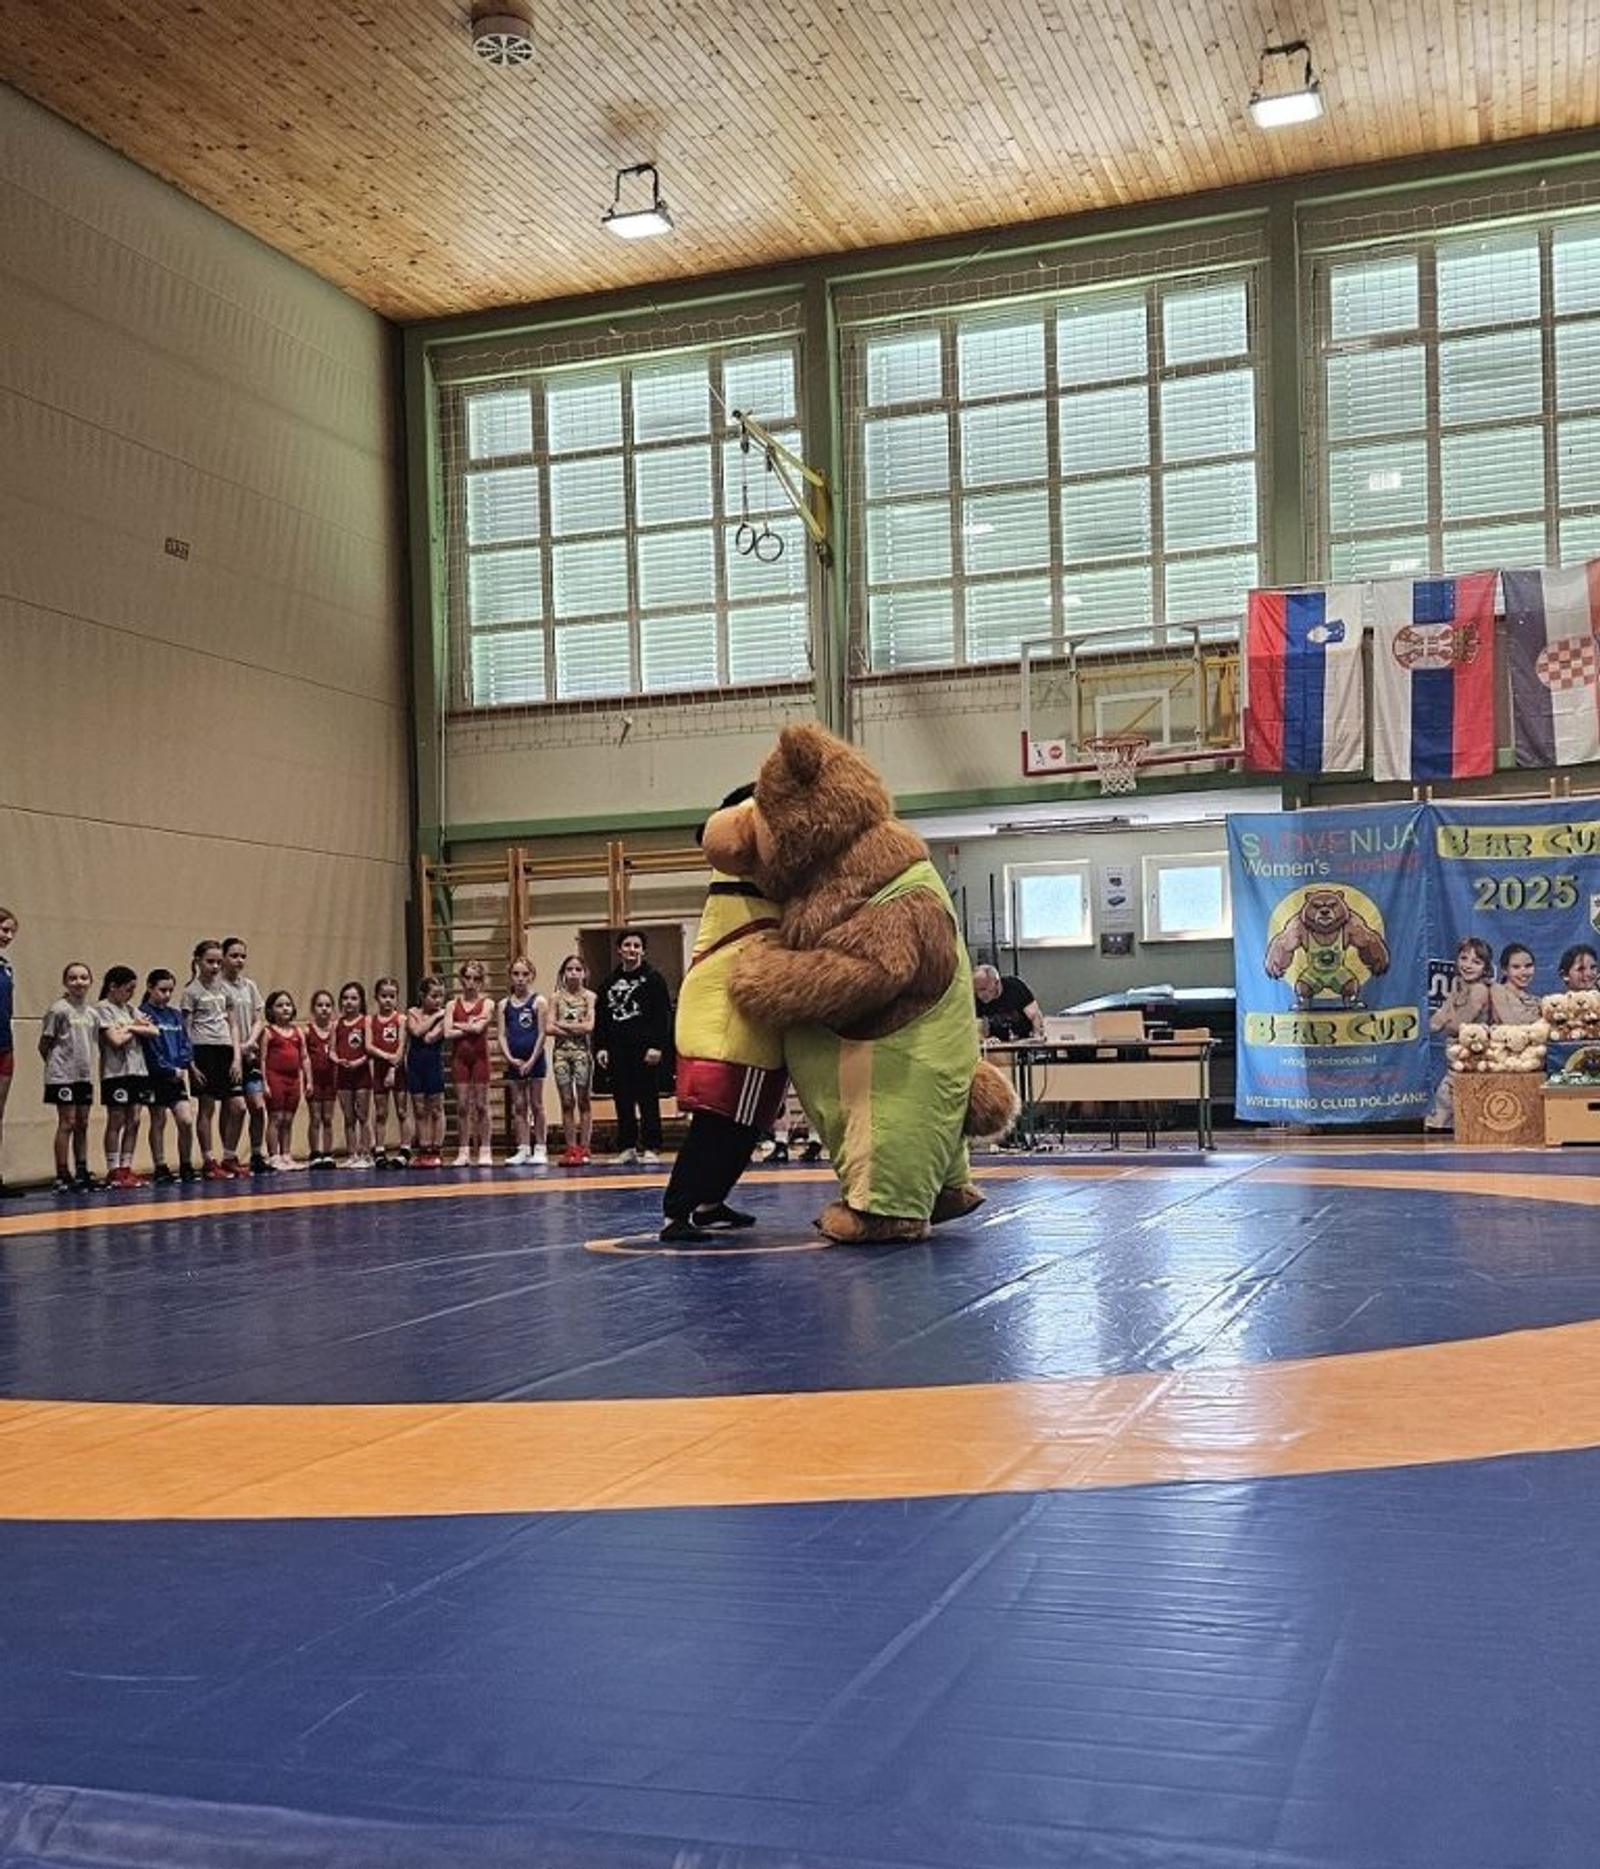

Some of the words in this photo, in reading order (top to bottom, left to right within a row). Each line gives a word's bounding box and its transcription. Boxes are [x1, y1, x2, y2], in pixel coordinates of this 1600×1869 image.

[1241, 823, 1420, 857] SLOVENIJA
[1444, 828, 1533, 856] BEAR
[1542, 825, 1600, 855] CU
[1243, 858, 1330, 877] Women's
[1473, 875, 1579, 911] 2025
[1250, 1014, 1337, 1045] BEAR
[1348, 1013, 1416, 1042] CUP
[1246, 1095, 1318, 1110] WRESTLING
[1321, 1098, 1357, 1110] CLUB
[1496, 1098, 1508, 1116] 2
